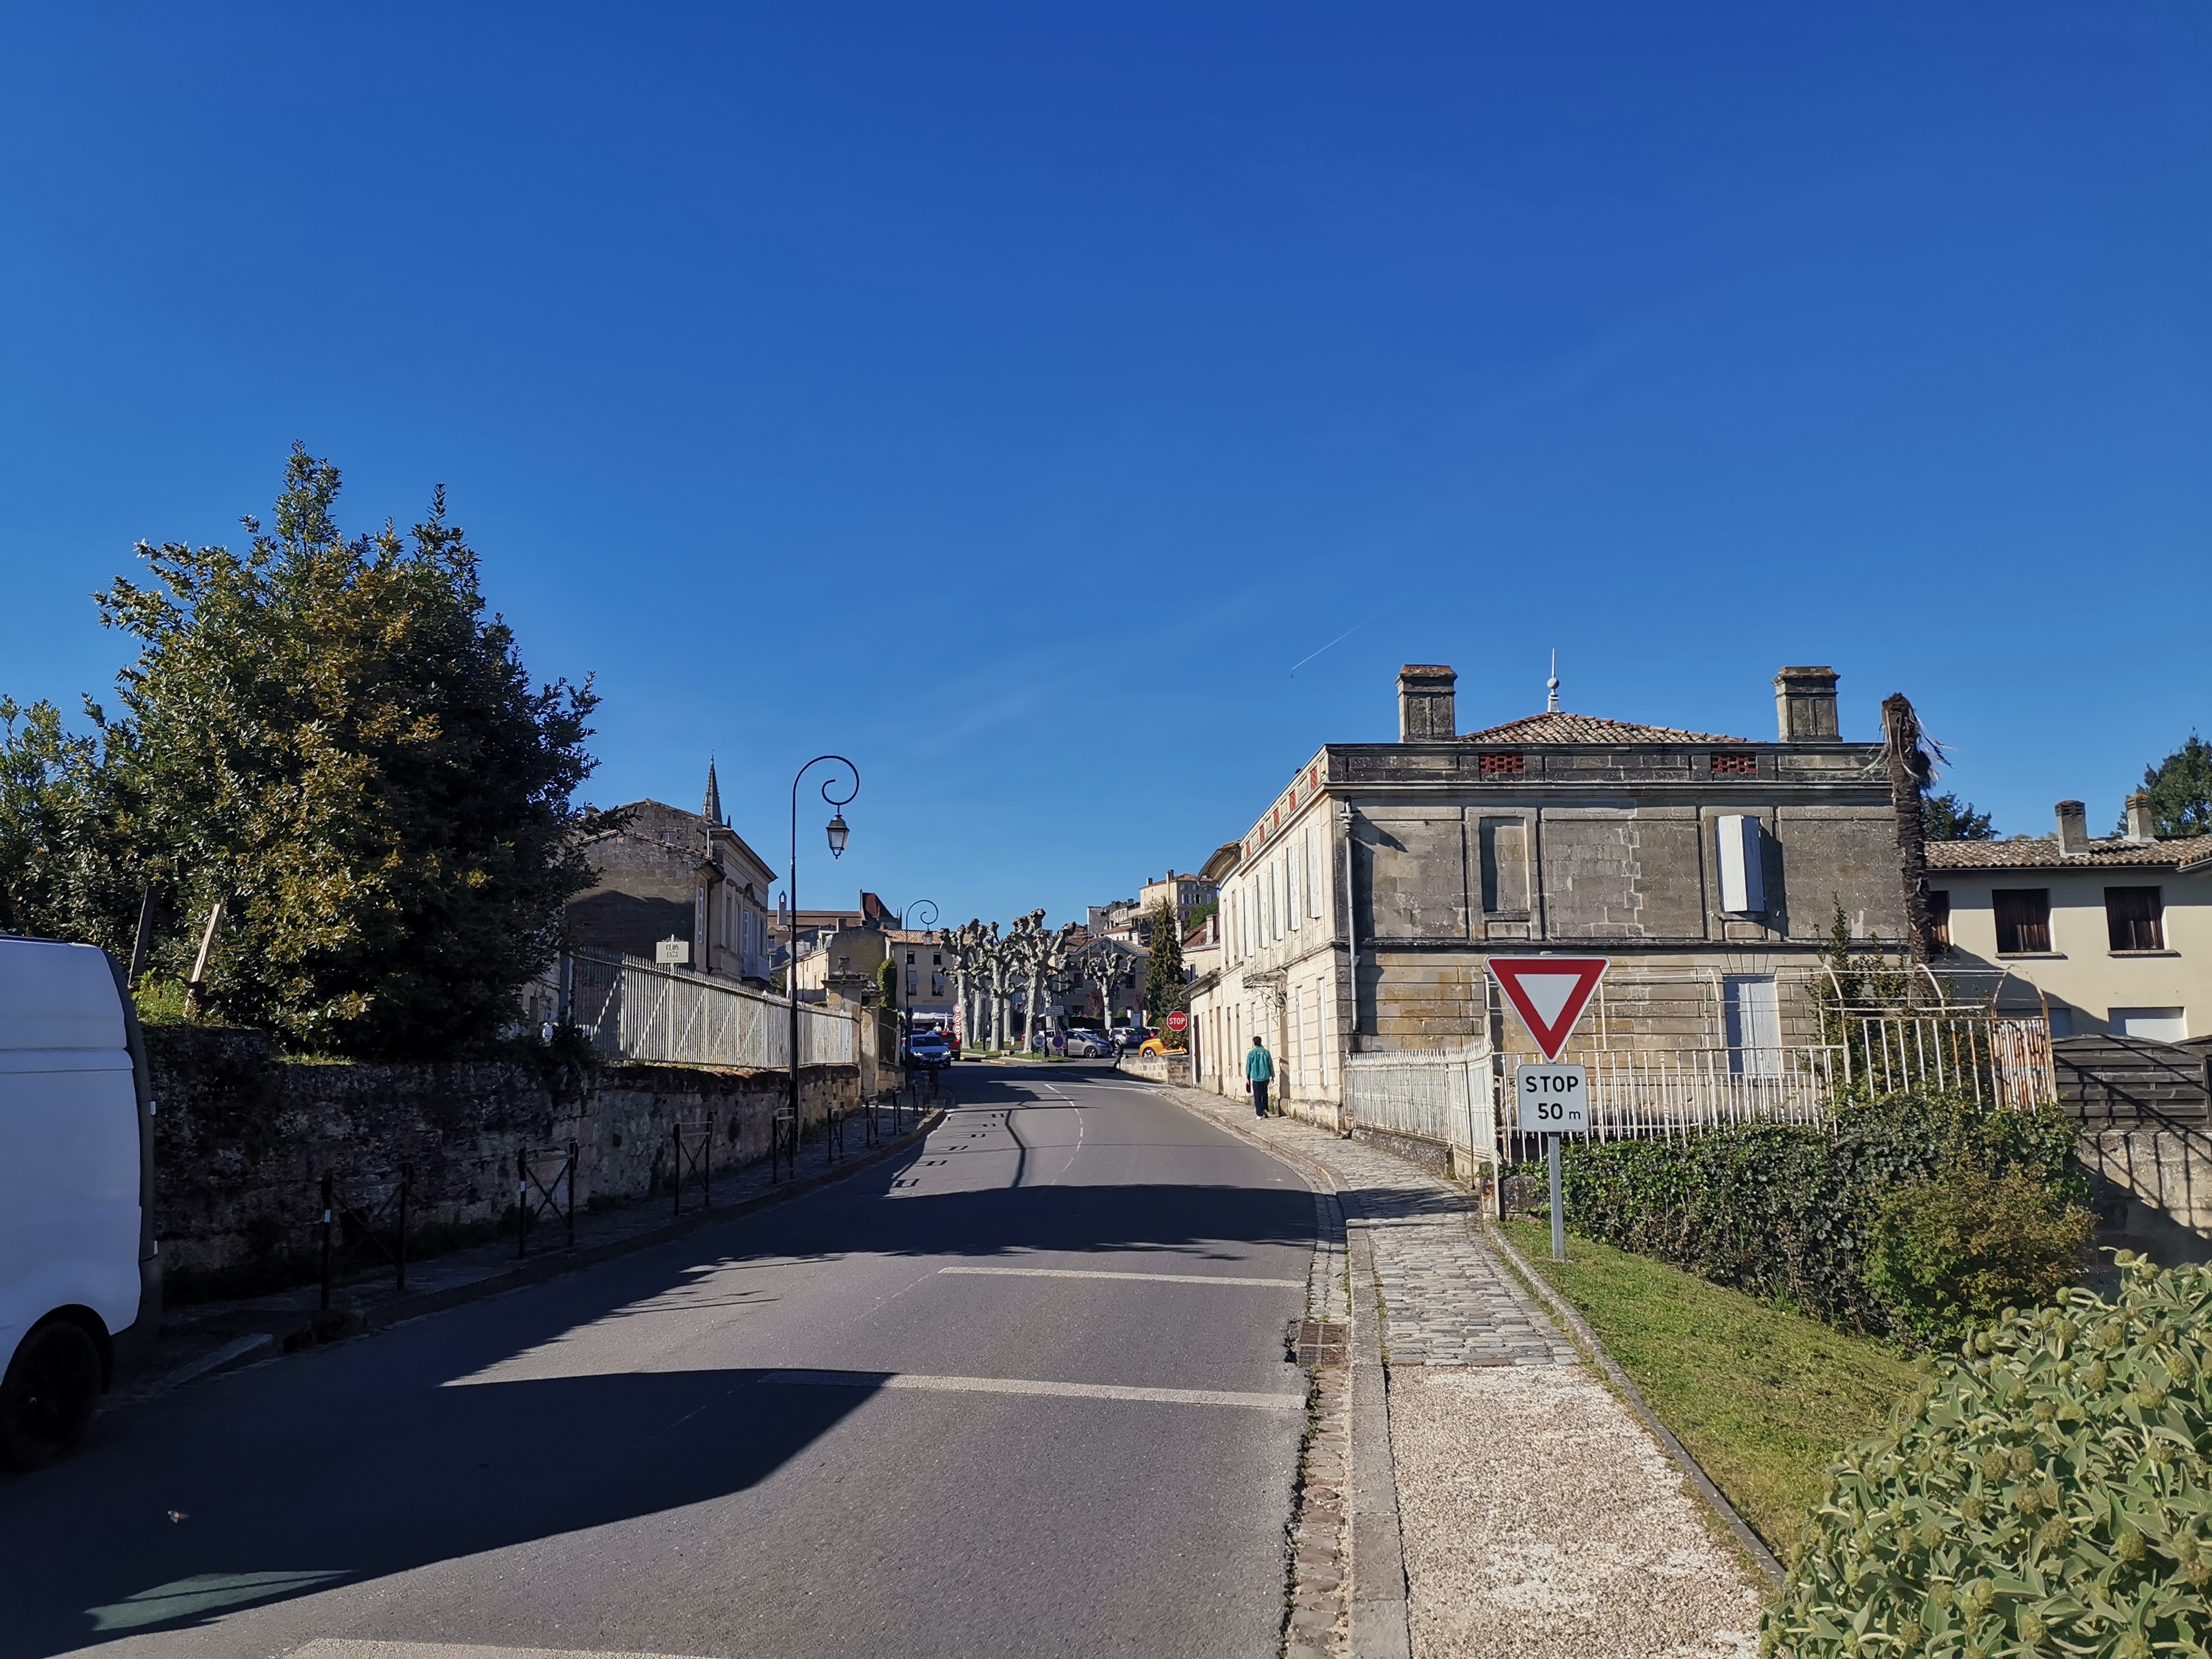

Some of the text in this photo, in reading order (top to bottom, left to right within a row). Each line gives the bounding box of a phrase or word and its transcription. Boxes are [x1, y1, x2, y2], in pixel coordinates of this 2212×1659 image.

[1525, 1076, 1579, 1093] STOP
[1537, 1103, 1581, 1120] 50 m
